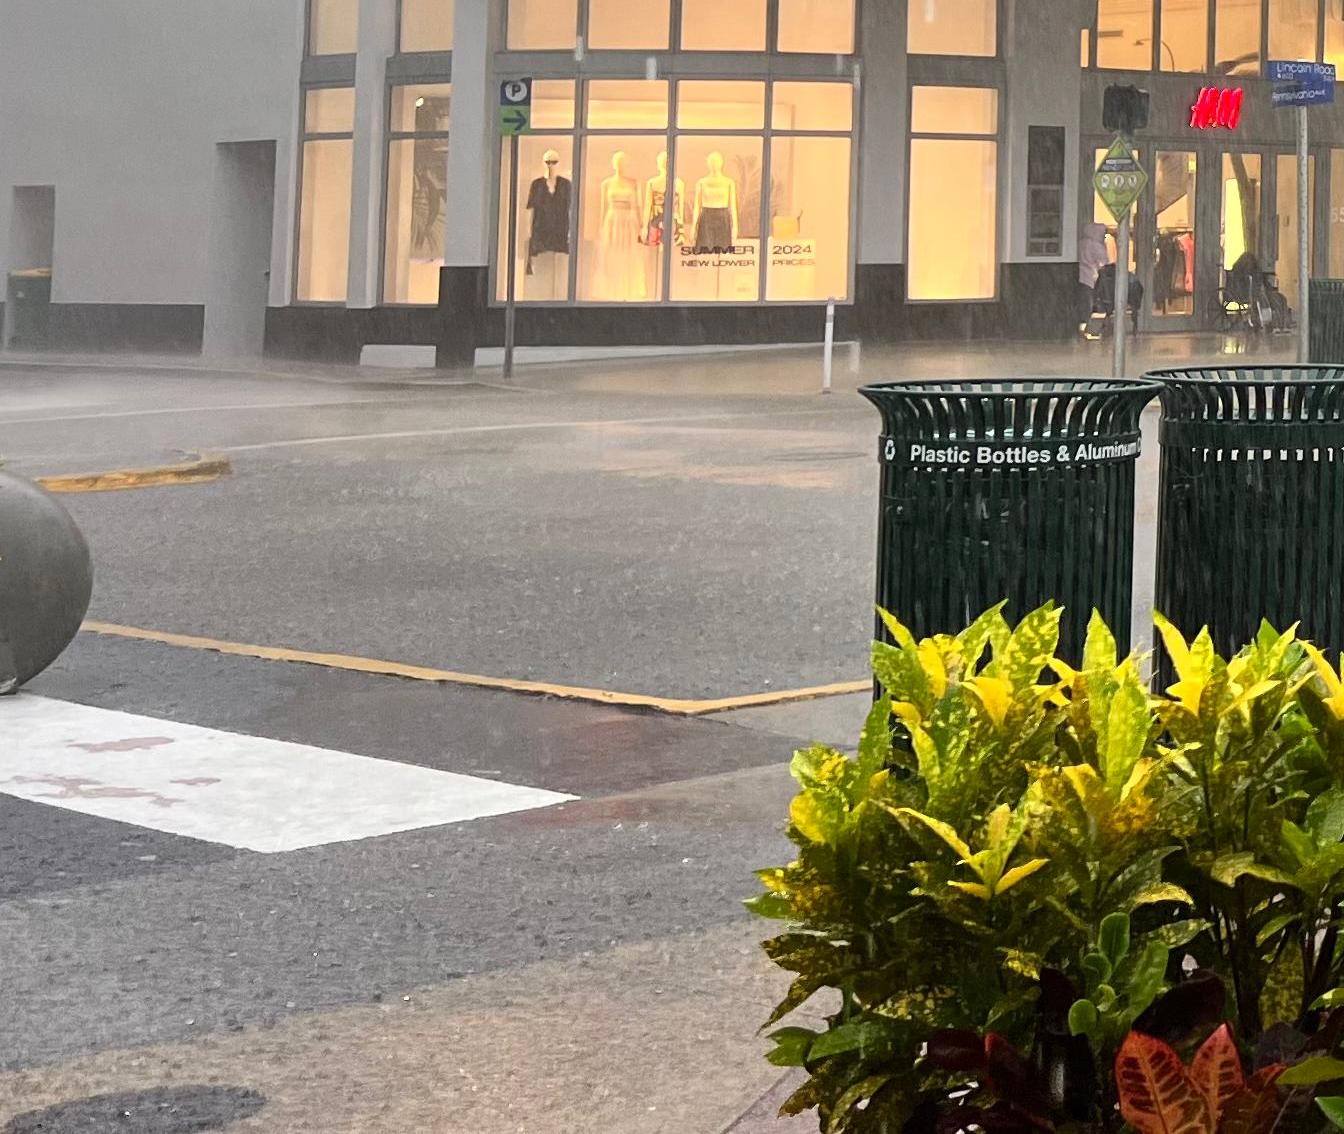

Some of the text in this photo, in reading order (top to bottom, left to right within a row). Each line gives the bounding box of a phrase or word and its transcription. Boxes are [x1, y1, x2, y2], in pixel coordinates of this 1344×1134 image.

[680, 245, 812, 255] SUMMER 2024
[681, 258, 816, 267] NEW LOWER PRICES
[910, 444, 971, 464] Plastic
[976, 445, 1051, 464] Bottles
[1056, 445, 1070, 462] &
[1075, 440, 1137, 461] Aluminum
